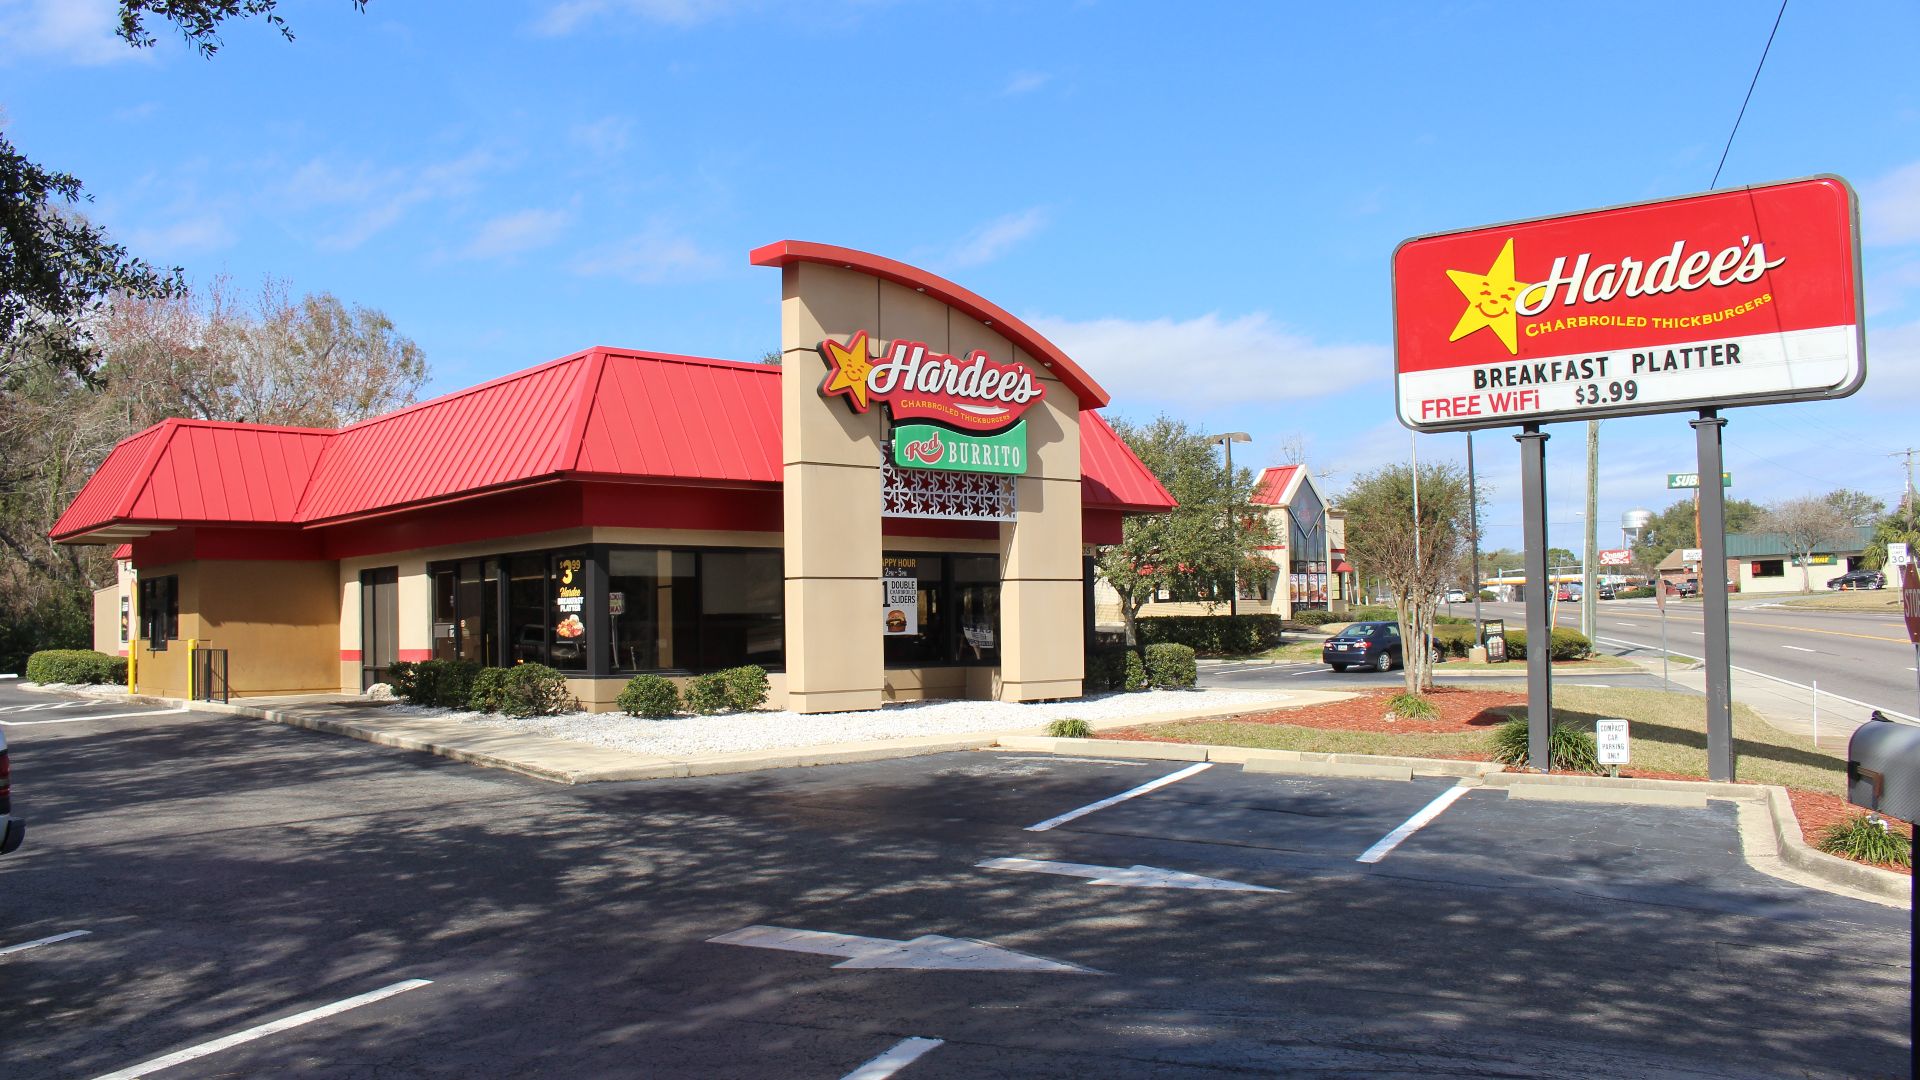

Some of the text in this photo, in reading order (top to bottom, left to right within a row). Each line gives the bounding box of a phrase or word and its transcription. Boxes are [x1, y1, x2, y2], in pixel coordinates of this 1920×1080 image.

[1515, 235, 1786, 317] Hardee's
[1525, 293, 1772, 338] CHARBROILED THICKBURGERS
[867, 344, 1042, 404] Hardee's
[1473, 343, 1741, 390] BREAKFAST PLATTER
[900, 399, 1010, 425] CHARBROILED THICKBURGERS
[1421, 380, 1638, 420] FREE WiFi $3.99
[905, 432, 1020, 467] Red BURRITO
[898, 558, 916, 568] HOUR
[1892, 556, 1905, 564] 30
[892, 580, 916, 589] DOUBLE
